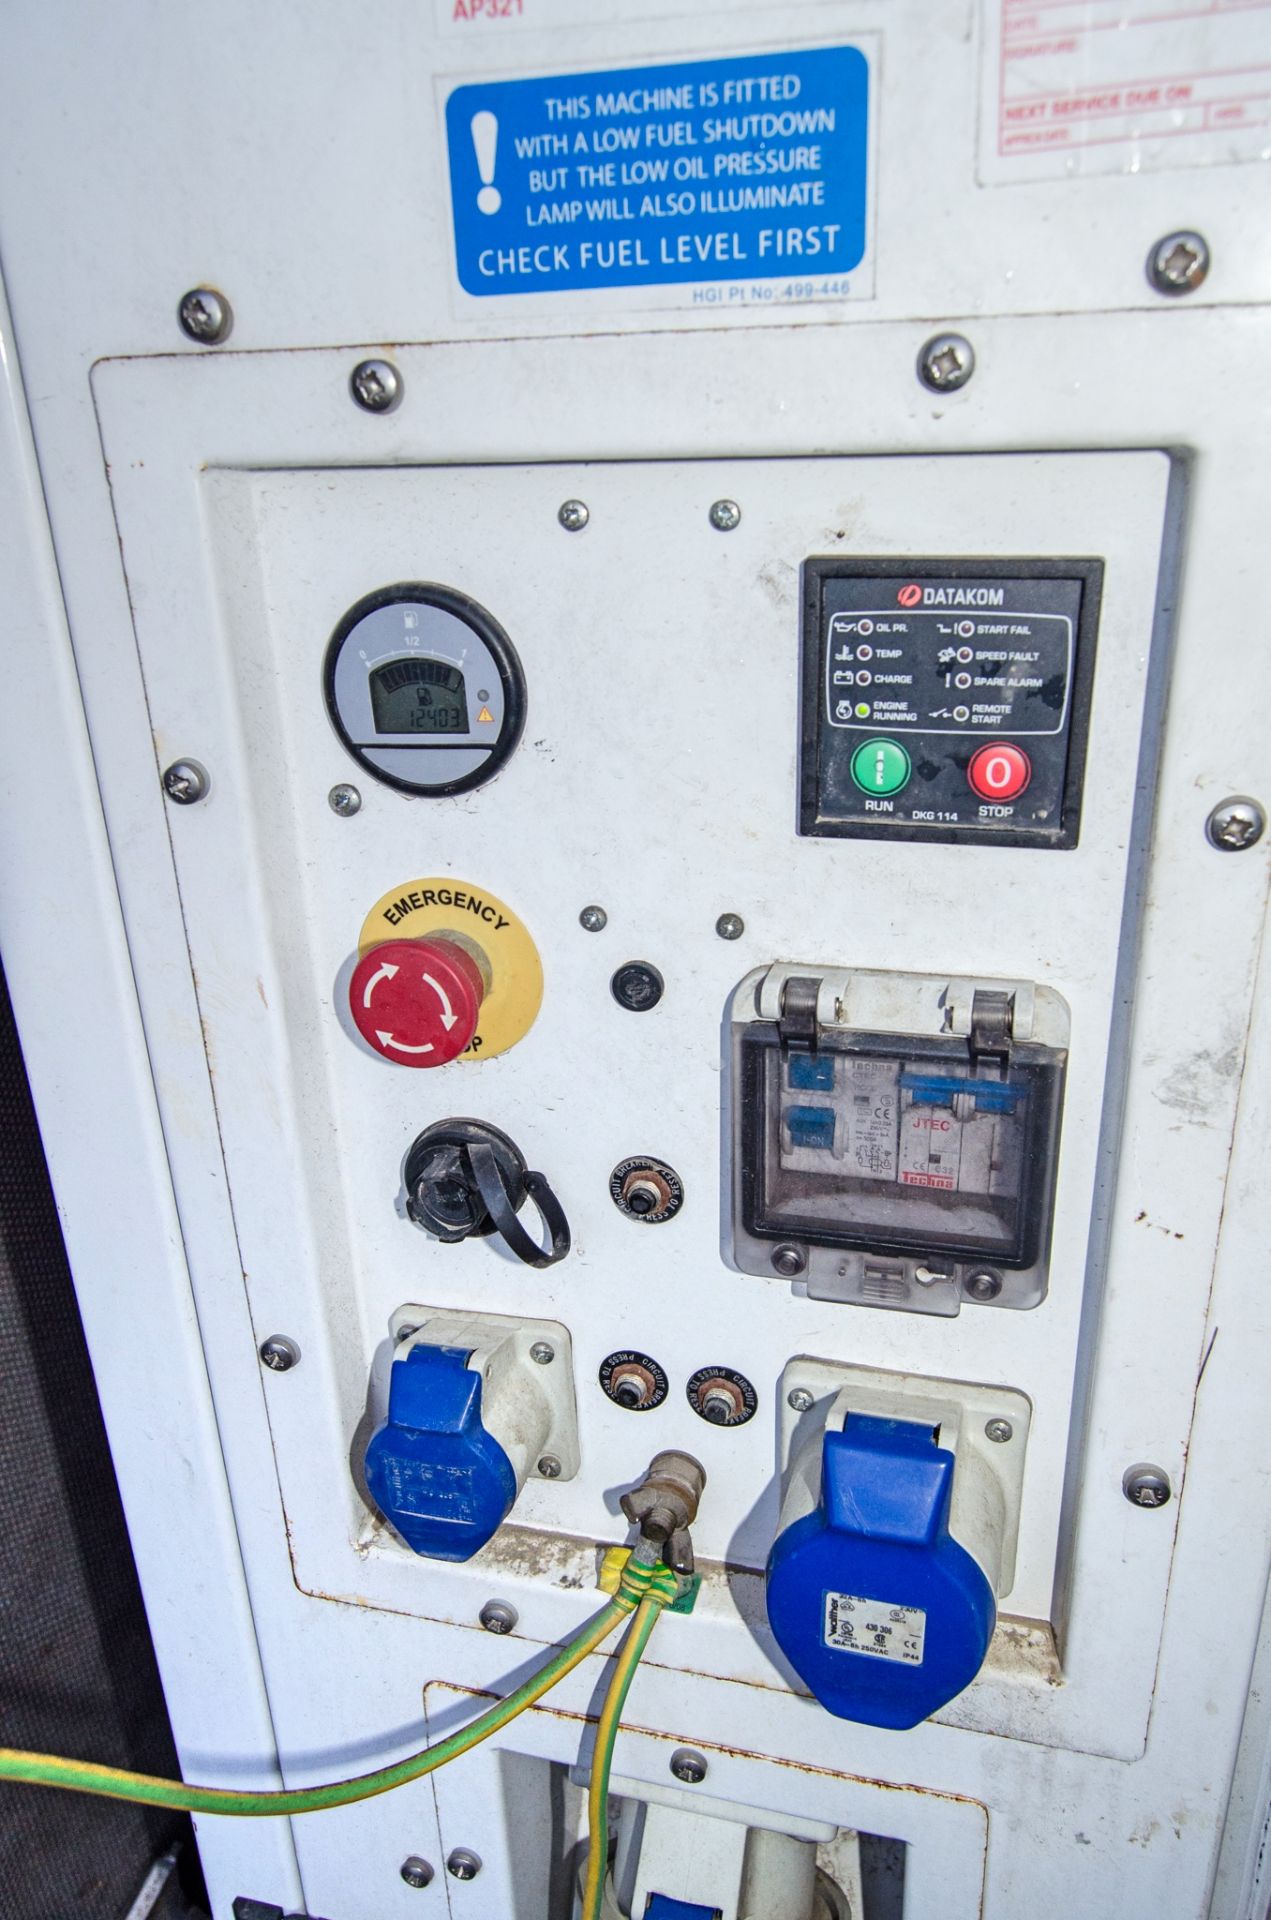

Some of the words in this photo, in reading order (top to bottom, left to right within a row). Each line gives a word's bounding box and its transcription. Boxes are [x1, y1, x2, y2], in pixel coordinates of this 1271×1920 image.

[545, 96, 591, 121] THIS
[596, 85, 693, 117] MACHINE
[700, 82, 719, 107] IS
[724, 74, 801, 104] FITTED
[1006, 104, 1047, 121] NEXT
[1052, 92, 1121, 116] SERVICE
[1126, 88, 1161, 108] DUE
[515, 132, 568, 159] WITH
[573, 131, 588, 154] A
[593, 126, 641, 153] LOW
[646, 121, 697, 148] FUEL
[703, 108, 835, 143] SHUTDOWN
[529, 167, 567, 193] BUT
[577, 162, 616, 188] THE
[622, 158, 669, 185] LOW
[674, 155, 708, 181] OIL
[715, 145, 821, 177] PRESSURE
[526, 203, 582, 226] LAMP
[587, 196, 634, 221] WILL
[640, 191, 695, 217] ALSO
[701, 181, 825, 213] ILLUMINATE
[478, 245, 570, 276] CHECK
[580, 239, 649, 268] FUEL
[661, 232, 747, 263] LEVEL
[758, 225, 840, 257] FIRST
[693, 287, 723, 303] HGI
[729, 285, 745, 301] Pt
[781, 280, 851, 300] 499-446
[923, 588, 1004, 606] DATAKOM
[876, 624, 891, 633] OIL
[977, 624, 1008, 635] START
[1010, 625, 1031, 635] FAIL
[404, 636, 420, 647] 1/2
[876, 649, 902, 659] TEMP
[975, 651, 1006, 661] SPEED
[1008, 652, 1040, 662] FAULT
[874, 674, 912, 685] CHARGE
[974, 676, 1005, 687] SPARE
[1007, 677, 1043, 688] ALARM
[873, 701, 908, 711] ENGINE
[972, 705, 1012, 715] REMOTE
[409, 708, 461, 729] 12403
[873, 712, 918, 722] RUNNING
[971, 714, 1003, 724] START
[865, 800, 894, 812] RUN
[978, 805, 1014, 818] STOP
[912, 810, 935, 821] DKG
[937, 811, 958, 822] 114
[383, 889, 510, 932] EMERGENCY
[874, 1107, 890, 1119] CE
[912, 1118, 951, 1131] JTEC
[661, 1170, 680, 1195] RESET
[902, 1171, 954, 1189] Techna
[612, 1179, 631, 1212] CIRCUIT
[668, 1198, 679, 1210] TO
[608, 1353, 635, 1366] PRESS
[602, 1366, 611, 1376] TO
[642, 1358, 665, 1387] CIRCUIT
[698, 1368, 726, 1381] PRESS
[689, 1380, 700, 1390] TO
[733, 1374, 754, 1406] CIRCUIT
[904, 1640, 917, 1649] CE
[902, 1652, 919, 1661] IP44
